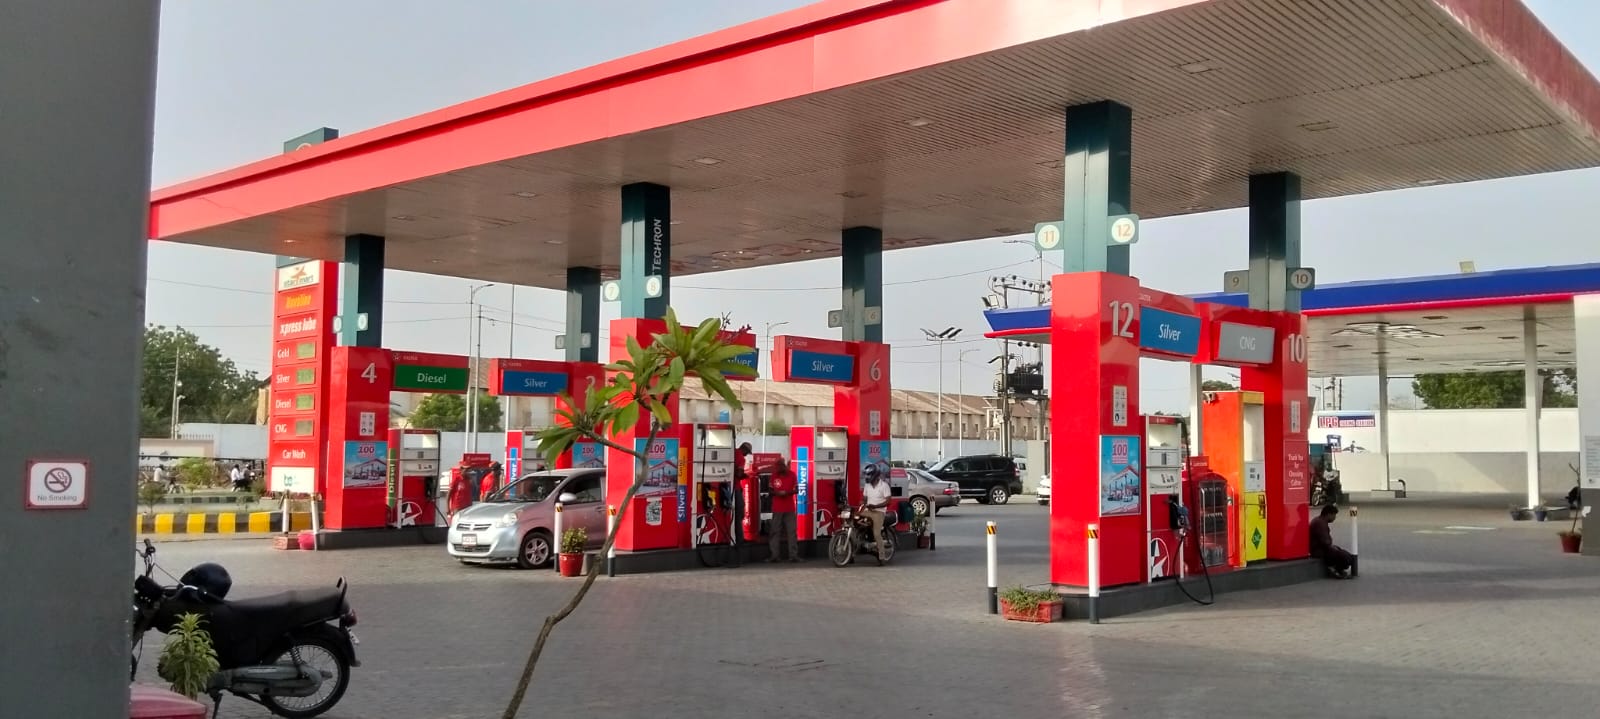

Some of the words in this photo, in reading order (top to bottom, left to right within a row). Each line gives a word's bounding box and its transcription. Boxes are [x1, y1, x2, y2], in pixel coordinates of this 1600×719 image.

[1116, 223, 1131, 236] 12
[1043, 231, 1055, 242] 11
[652, 219, 663, 272] TECHRON
[1232, 277, 1240, 287] 9
[1294, 274, 1309, 284] 10
[1109, 301, 1134, 339] 12
[1158, 323, 1181, 342] Silver
[1239, 337, 1256, 351] CNG
[1288, 333, 1305, 364] 10
[811, 360, 834, 373] Silver
[870, 359, 881, 381] 6
[276, 374, 290, 384] Silver
[361, 363, 377, 383] 4
[417, 372, 447, 384] Diesel
[524, 378, 547, 388] Silver
[275, 399, 291, 409] Diesel
[274, 424, 287, 433] CNG
[282, 450, 291, 459] Car
[358, 446, 375, 454] 100
[1112, 444, 1128, 456] 100
[799, 465, 808, 496] Silver
[48, 494, 78, 502] Smoking
[678, 489, 686, 518] Silver
